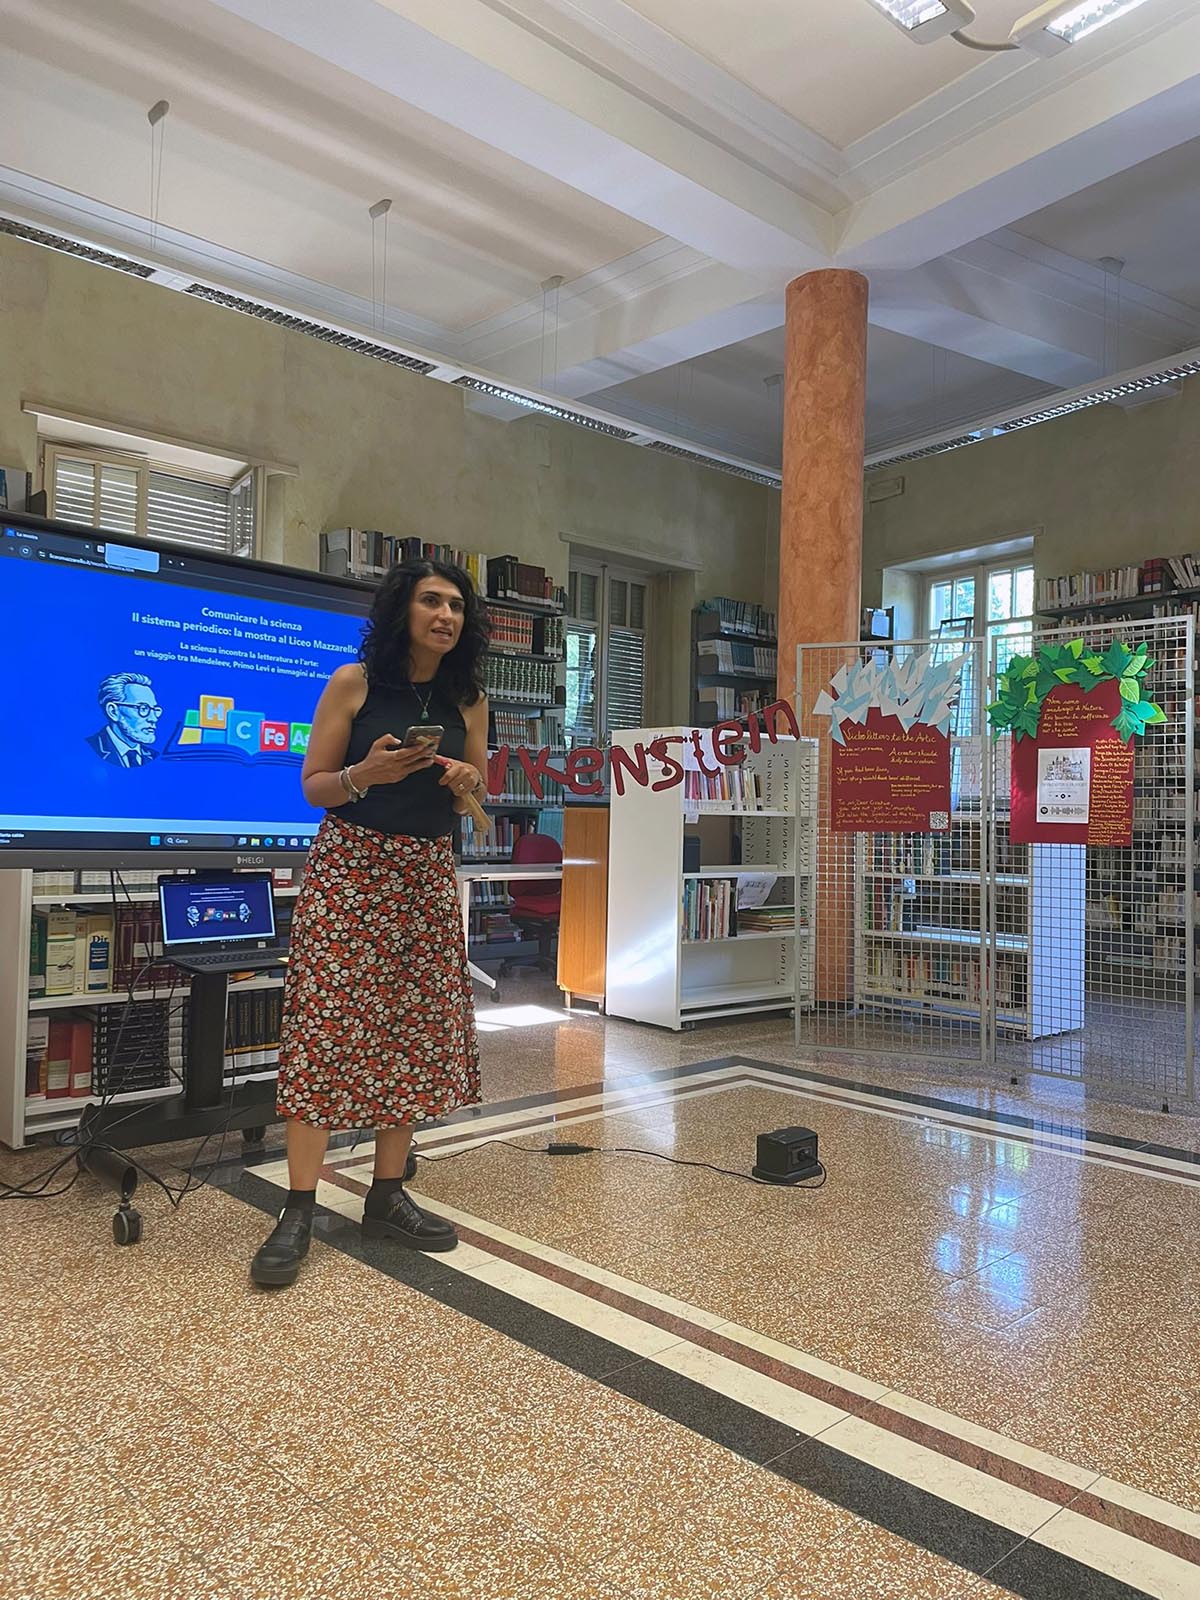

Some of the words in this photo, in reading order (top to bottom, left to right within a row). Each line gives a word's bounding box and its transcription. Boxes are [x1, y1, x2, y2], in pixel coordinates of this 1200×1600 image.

[201, 607, 258, 624] Comunicare
[260, 616, 268, 626] la
[270, 619, 303, 631] scienza
[132, 612, 140, 622] Il
[141, 614, 180, 628] sistema
[183, 622, 232, 636] periodico:
[234, 627, 242, 638] la
[244, 631, 277, 643] mostra
[278, 635, 287, 644] al
[289, 636, 312, 648] Liceo
[313, 640, 359, 655] Mazzarello
[146, 650, 176, 661] viaggio
[177, 654, 189, 662] tra
[190, 655, 232, 668] Mendeleev,
[233, 661, 254, 671] Primo
[256, 664, 270, 673] Levi
[277, 667, 308, 678] immagini
[180, 642, 189, 650] La
[190, 644, 217, 654] scienza
[218, 647, 248, 658] incontra
[249, 651, 256, 659] la
[257, 652, 293, 664] letteratura
[300, 658, 320, 668] l'arte:
[207, 702, 225, 721] H
[236, 721, 252, 740] C
[264, 728, 286, 746] Fe
[242, 856, 264, 864] HELGI
